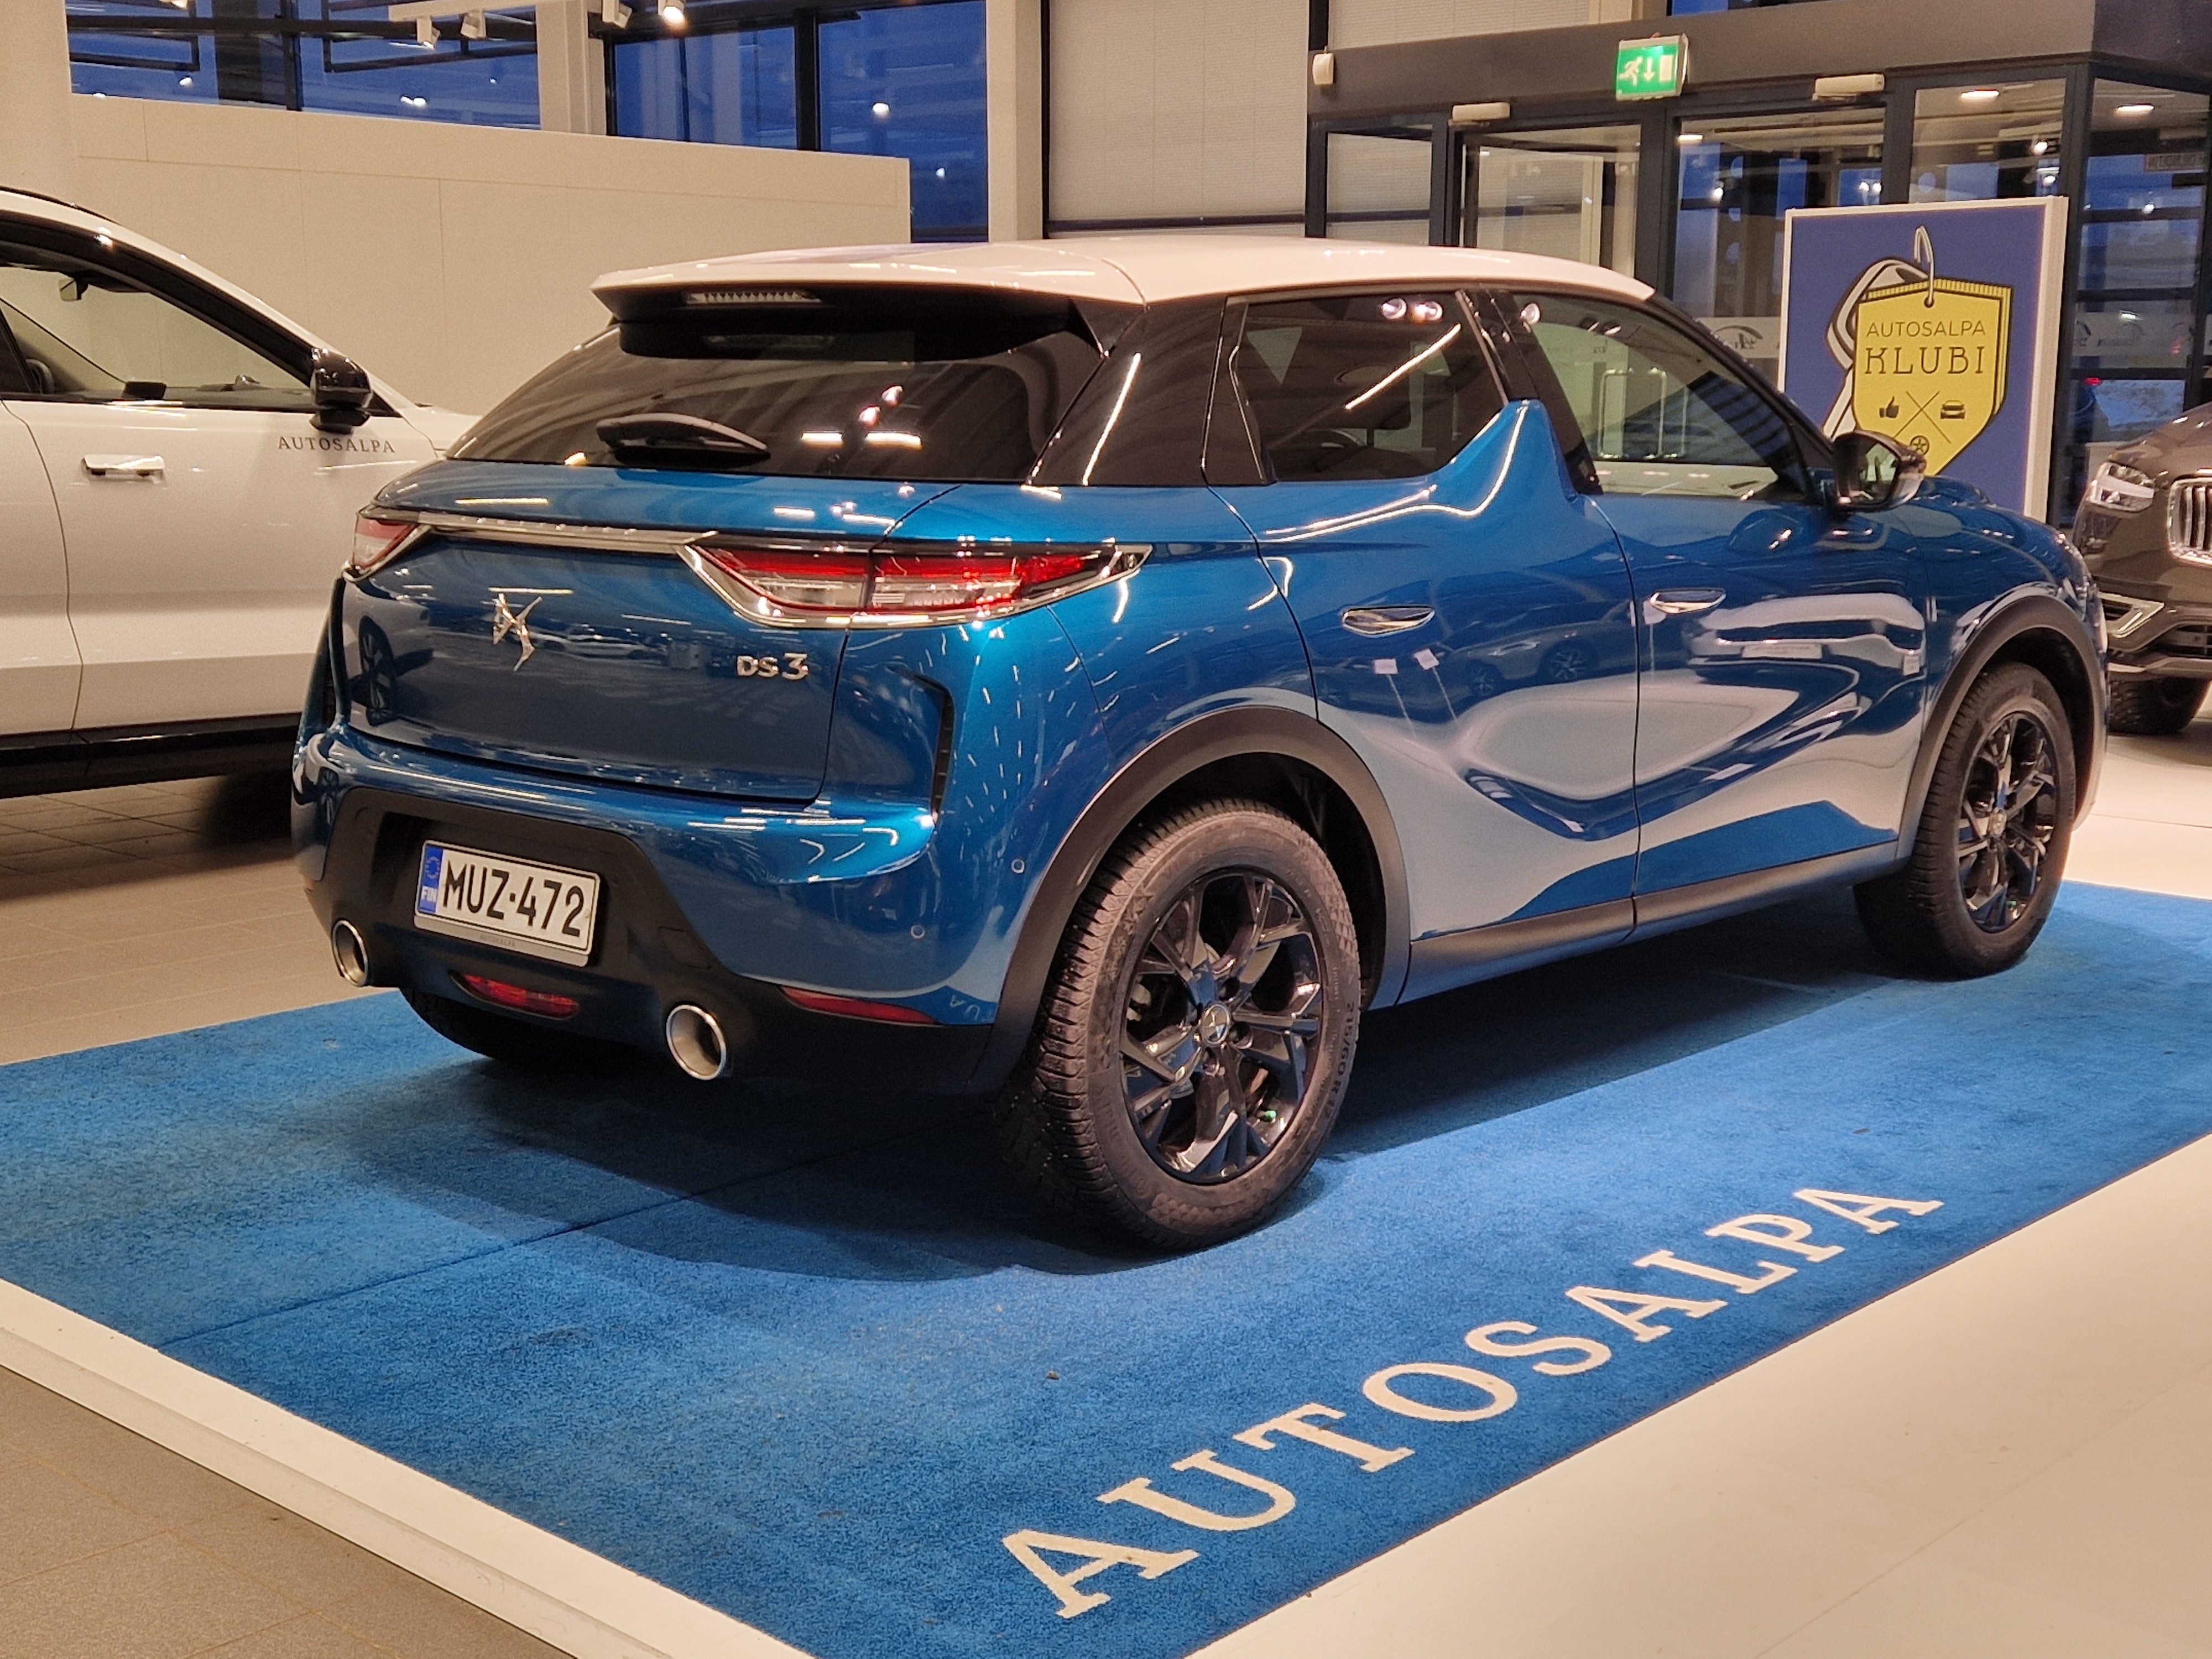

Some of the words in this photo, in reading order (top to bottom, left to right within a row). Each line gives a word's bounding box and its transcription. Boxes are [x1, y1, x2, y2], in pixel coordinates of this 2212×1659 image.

[1866, 320, 1985, 337] AUTOSALPA
[1865, 346, 1984, 374] KLUBI
[278, 436, 395, 453] AUTOSALPA
[421, 885, 437, 902] FIN
[443, 859, 584, 937] MUZ-472
[1003, 1188, 1944, 1619] AUTOSALPA
